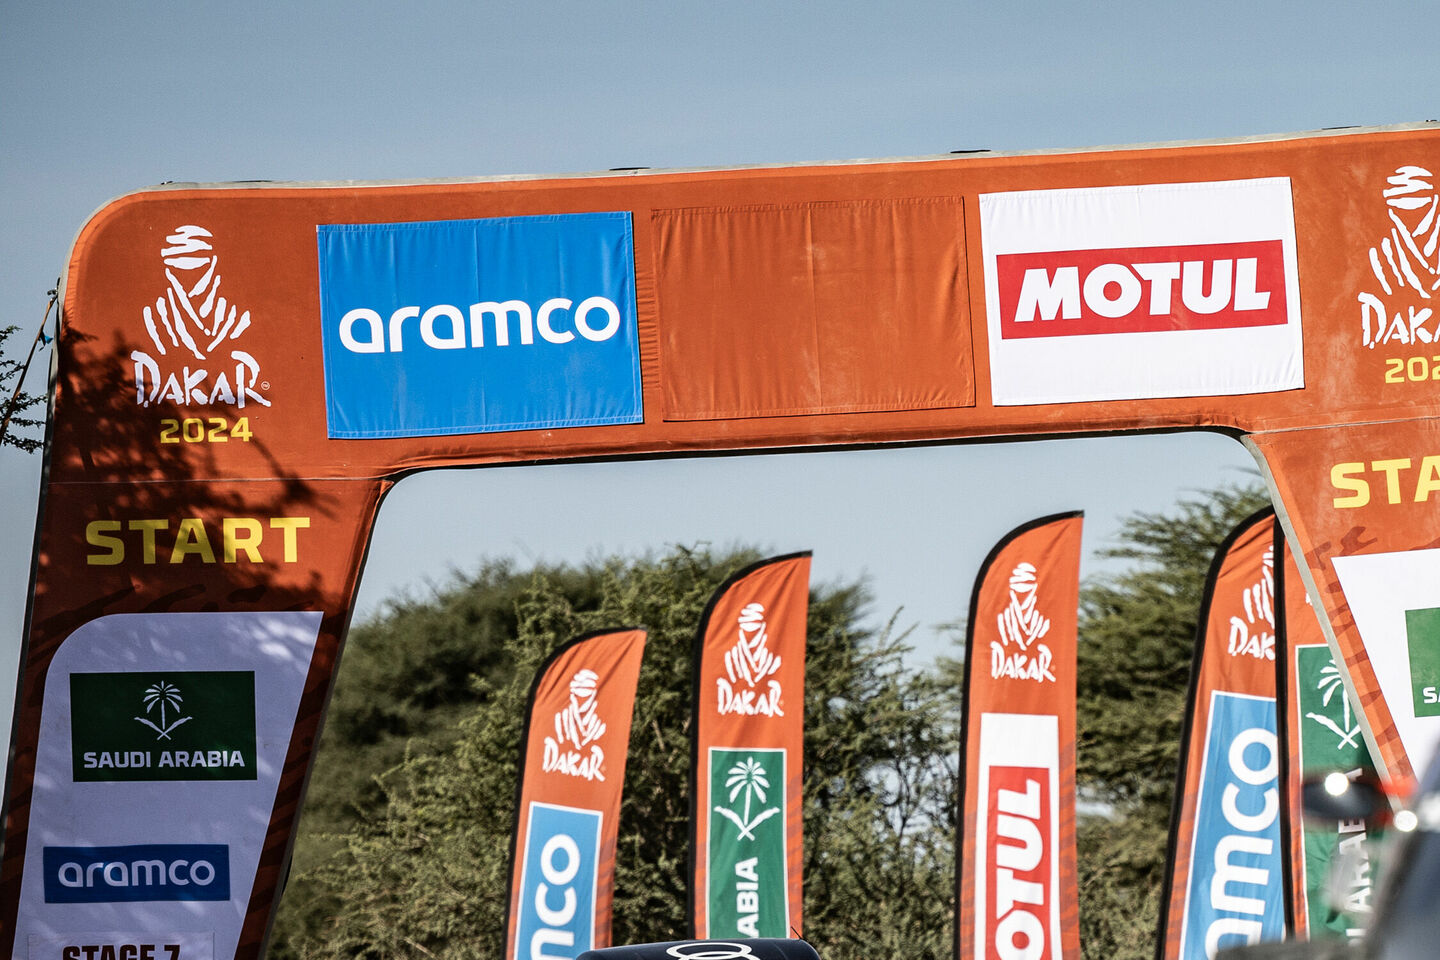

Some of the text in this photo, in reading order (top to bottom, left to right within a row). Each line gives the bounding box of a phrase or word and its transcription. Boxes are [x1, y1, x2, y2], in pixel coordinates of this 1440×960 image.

[1014, 257, 1271, 323] MOTUL
[338, 296, 621, 354] aramco
[131, 350, 272, 409] DAKAR
[159, 417, 254, 444] 2024
[86, 516, 310, 566] START
[1228, 616, 1276, 661] DAK
[990, 641, 1056, 683] DAKAR
[717, 678, 784, 717] DAKAR
[83, 750, 245, 769] SAUDI ARABIA
[543, 736, 606, 781] DAKAR
[58, 859, 215, 888] aramco
[736, 857, 760, 938] ABIA
